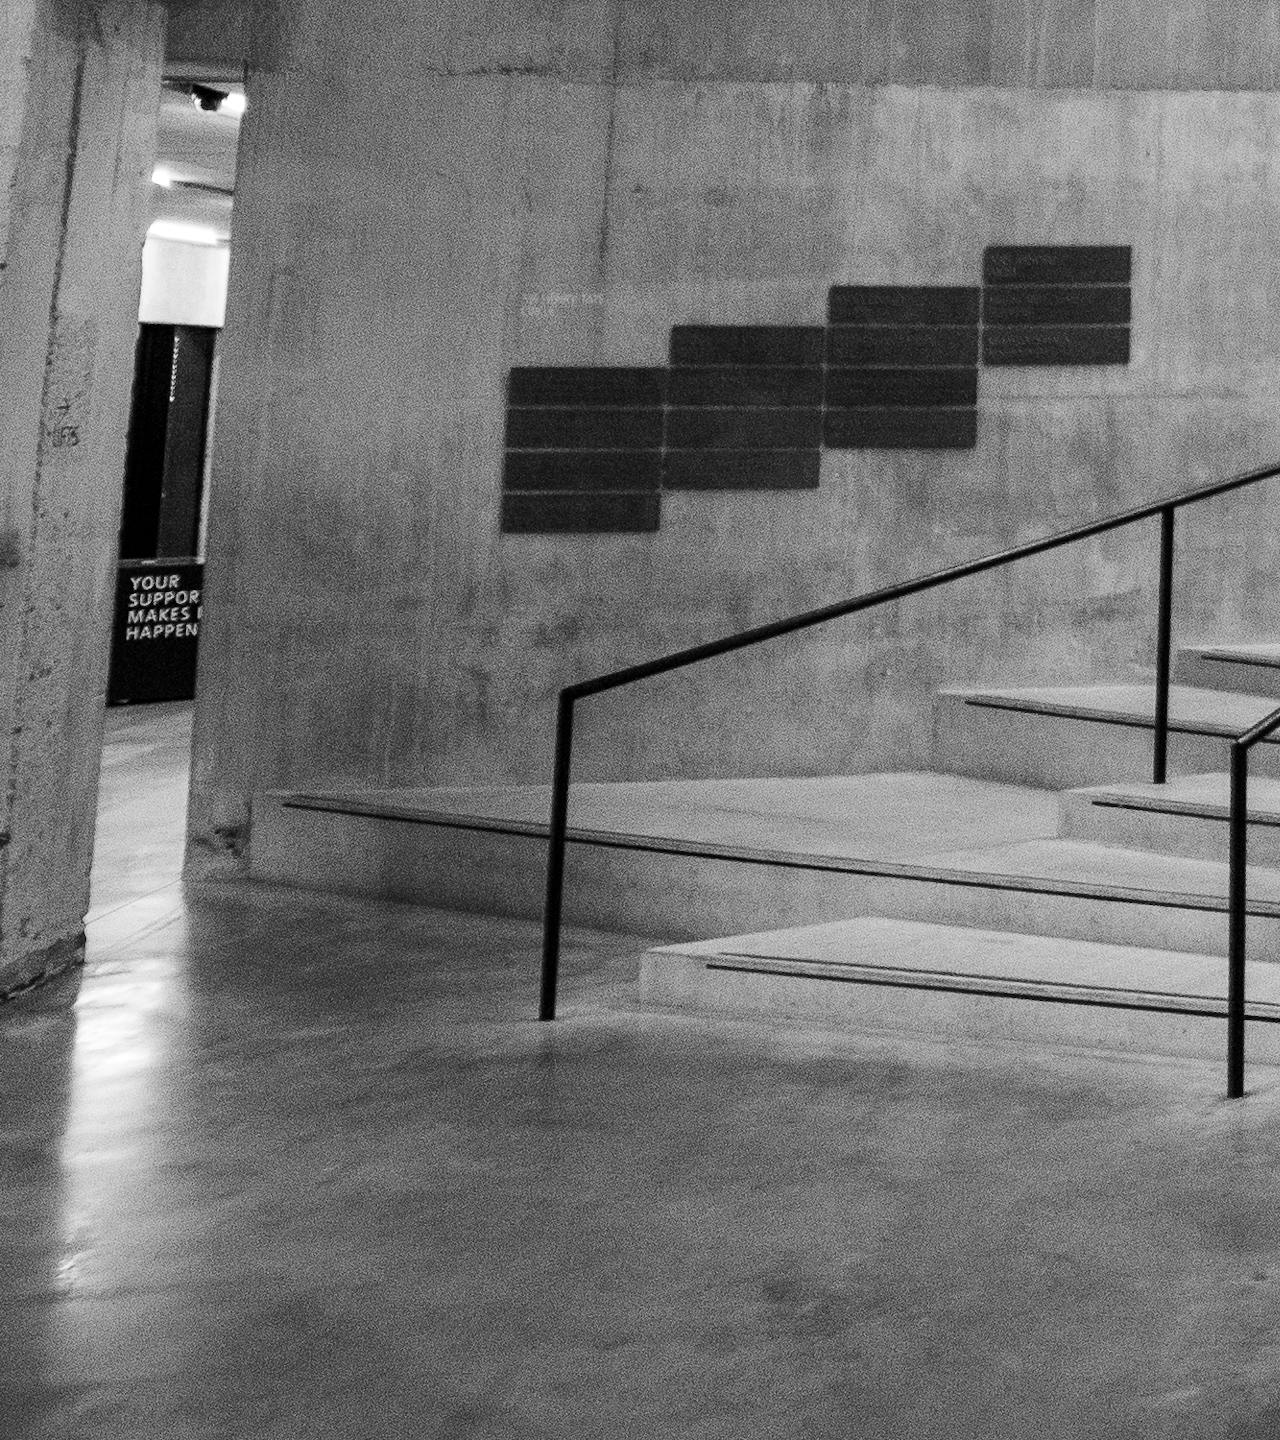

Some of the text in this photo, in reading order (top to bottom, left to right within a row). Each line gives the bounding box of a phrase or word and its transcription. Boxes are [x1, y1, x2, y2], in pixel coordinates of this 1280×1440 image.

[131, 575, 179, 590] YOUR
[129, 590, 199, 607] SUPPOR
[128, 606, 189, 623] MAKES
[126, 623, 198, 640] HAPPEN
